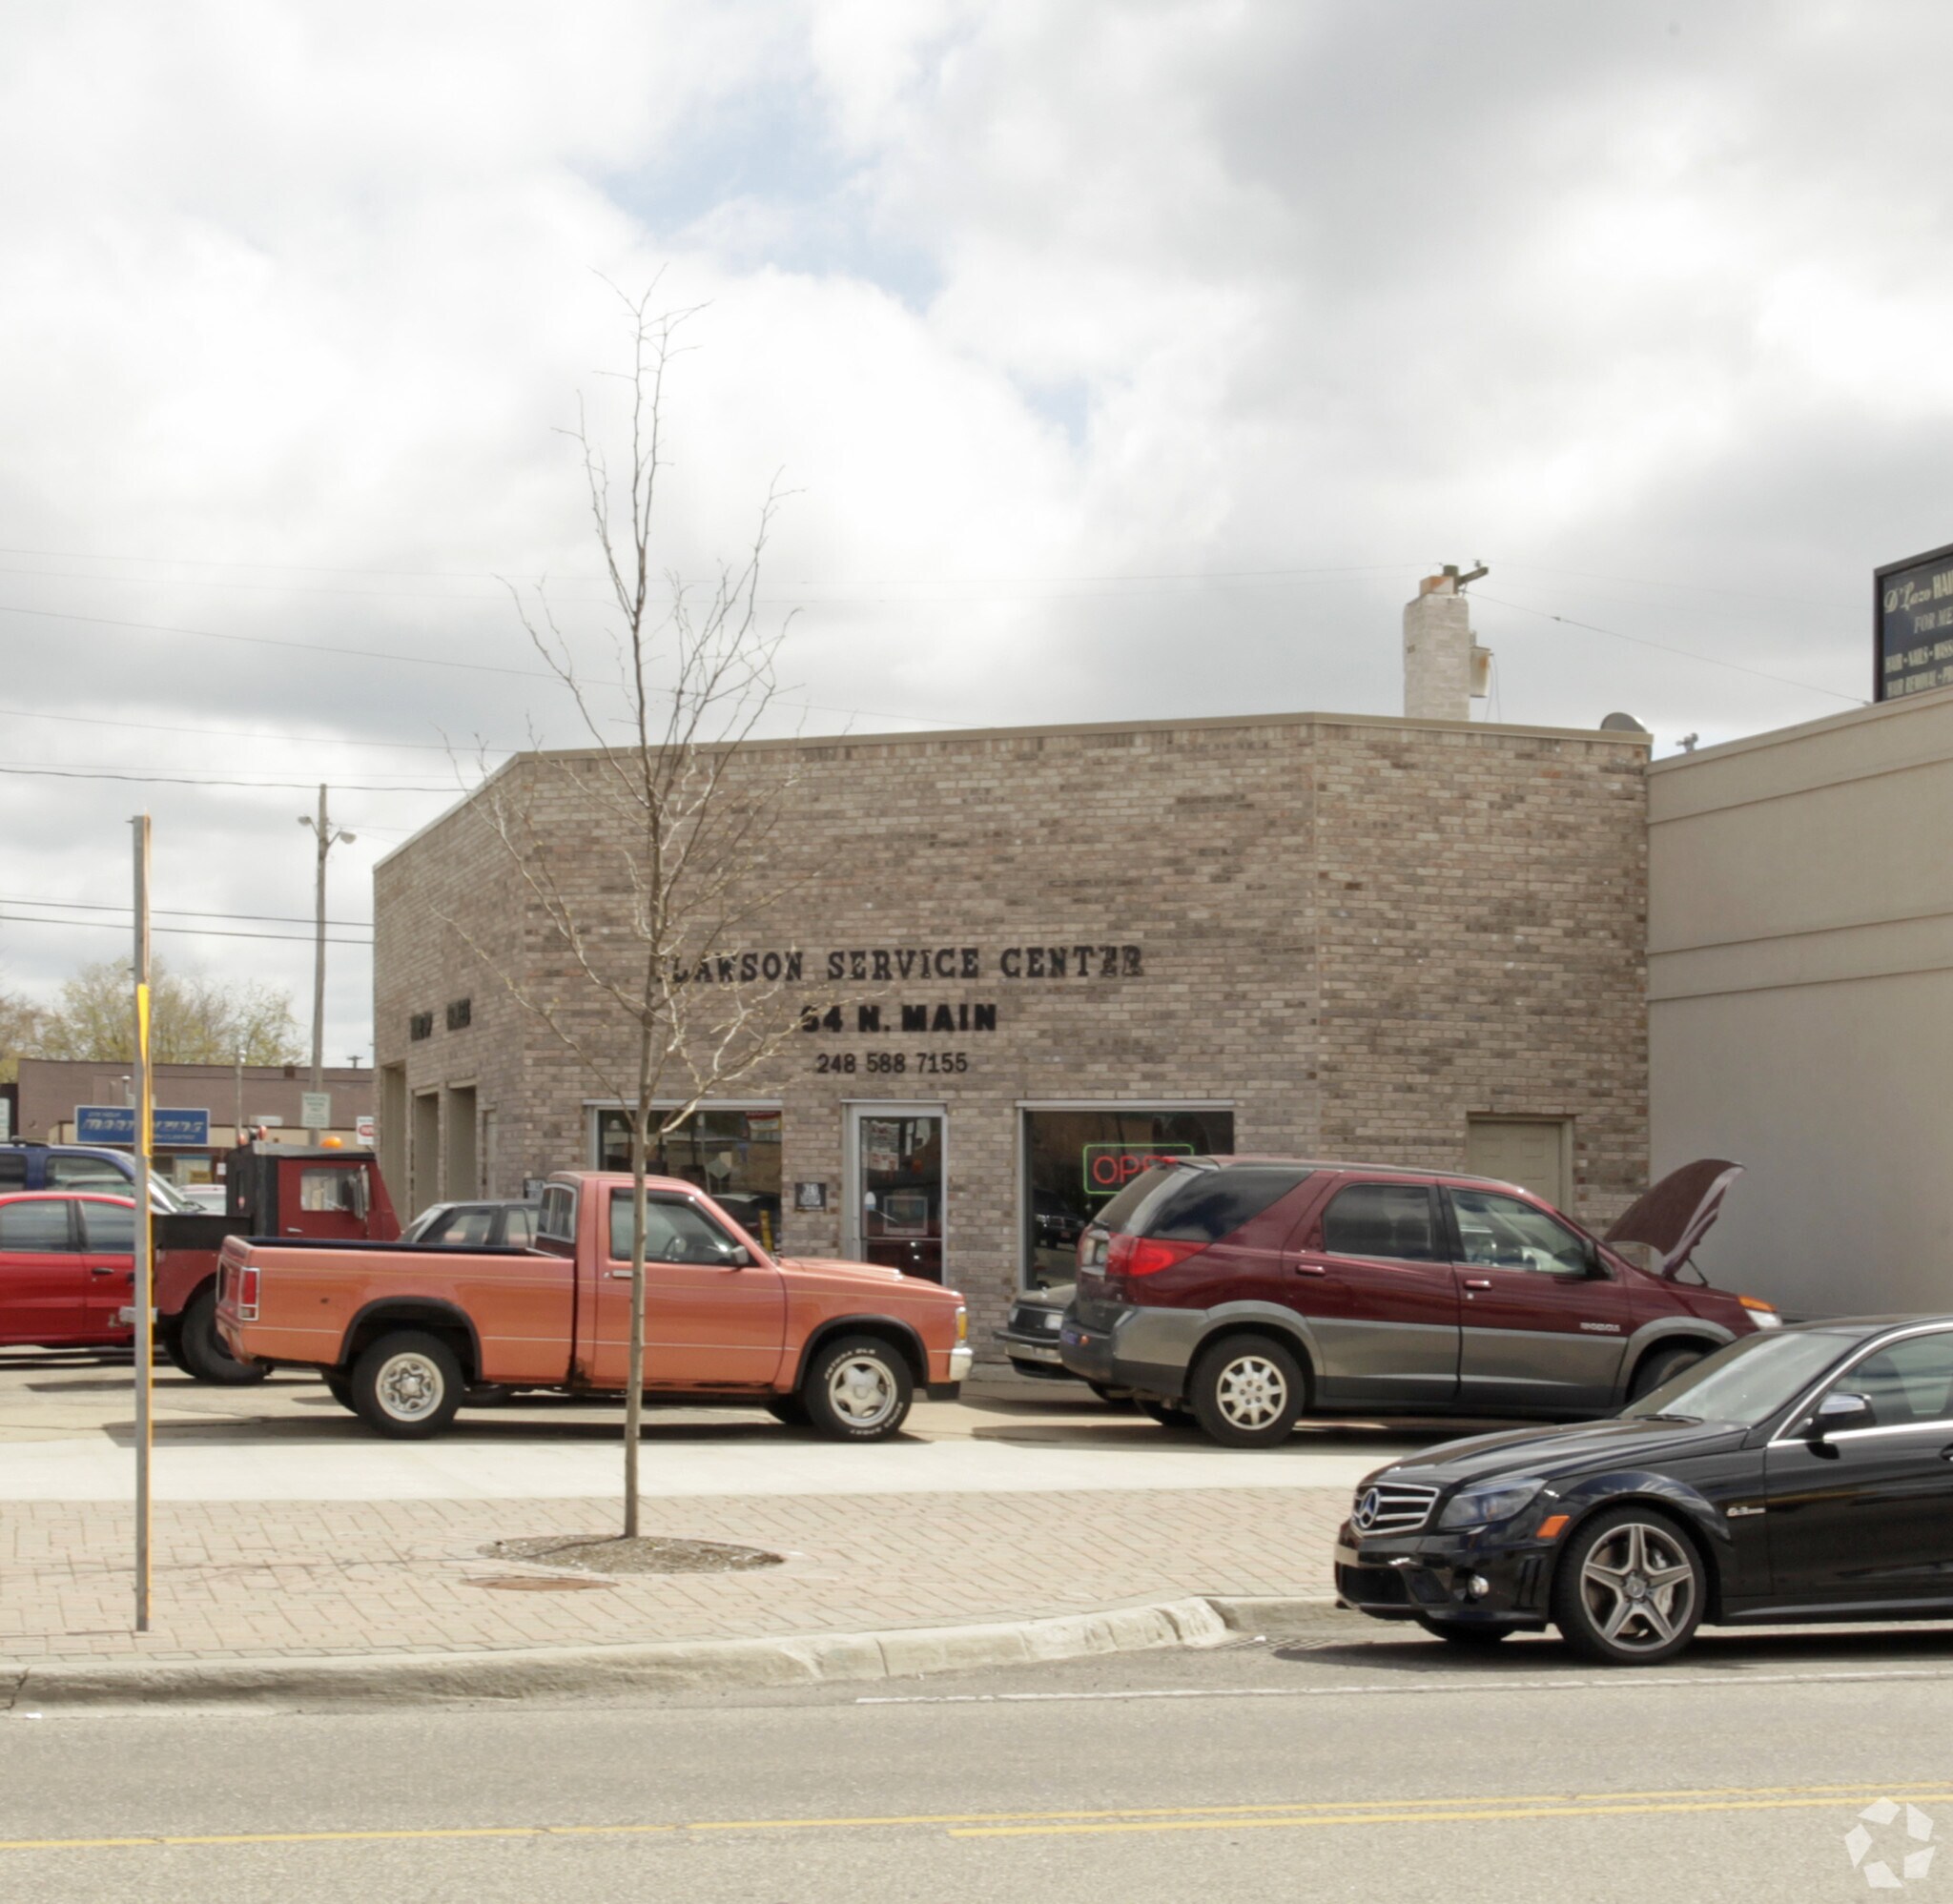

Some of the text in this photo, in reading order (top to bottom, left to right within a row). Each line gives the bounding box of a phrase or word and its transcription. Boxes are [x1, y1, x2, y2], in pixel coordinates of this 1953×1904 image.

[828, 948, 979, 981] SERVICE
[1000, 945, 1143, 977] CENTER
[858, 1005, 890, 1032] N.
[901, 1004, 997, 1032] MAIN
[817, 1053, 968, 1074] 248 588 7155
